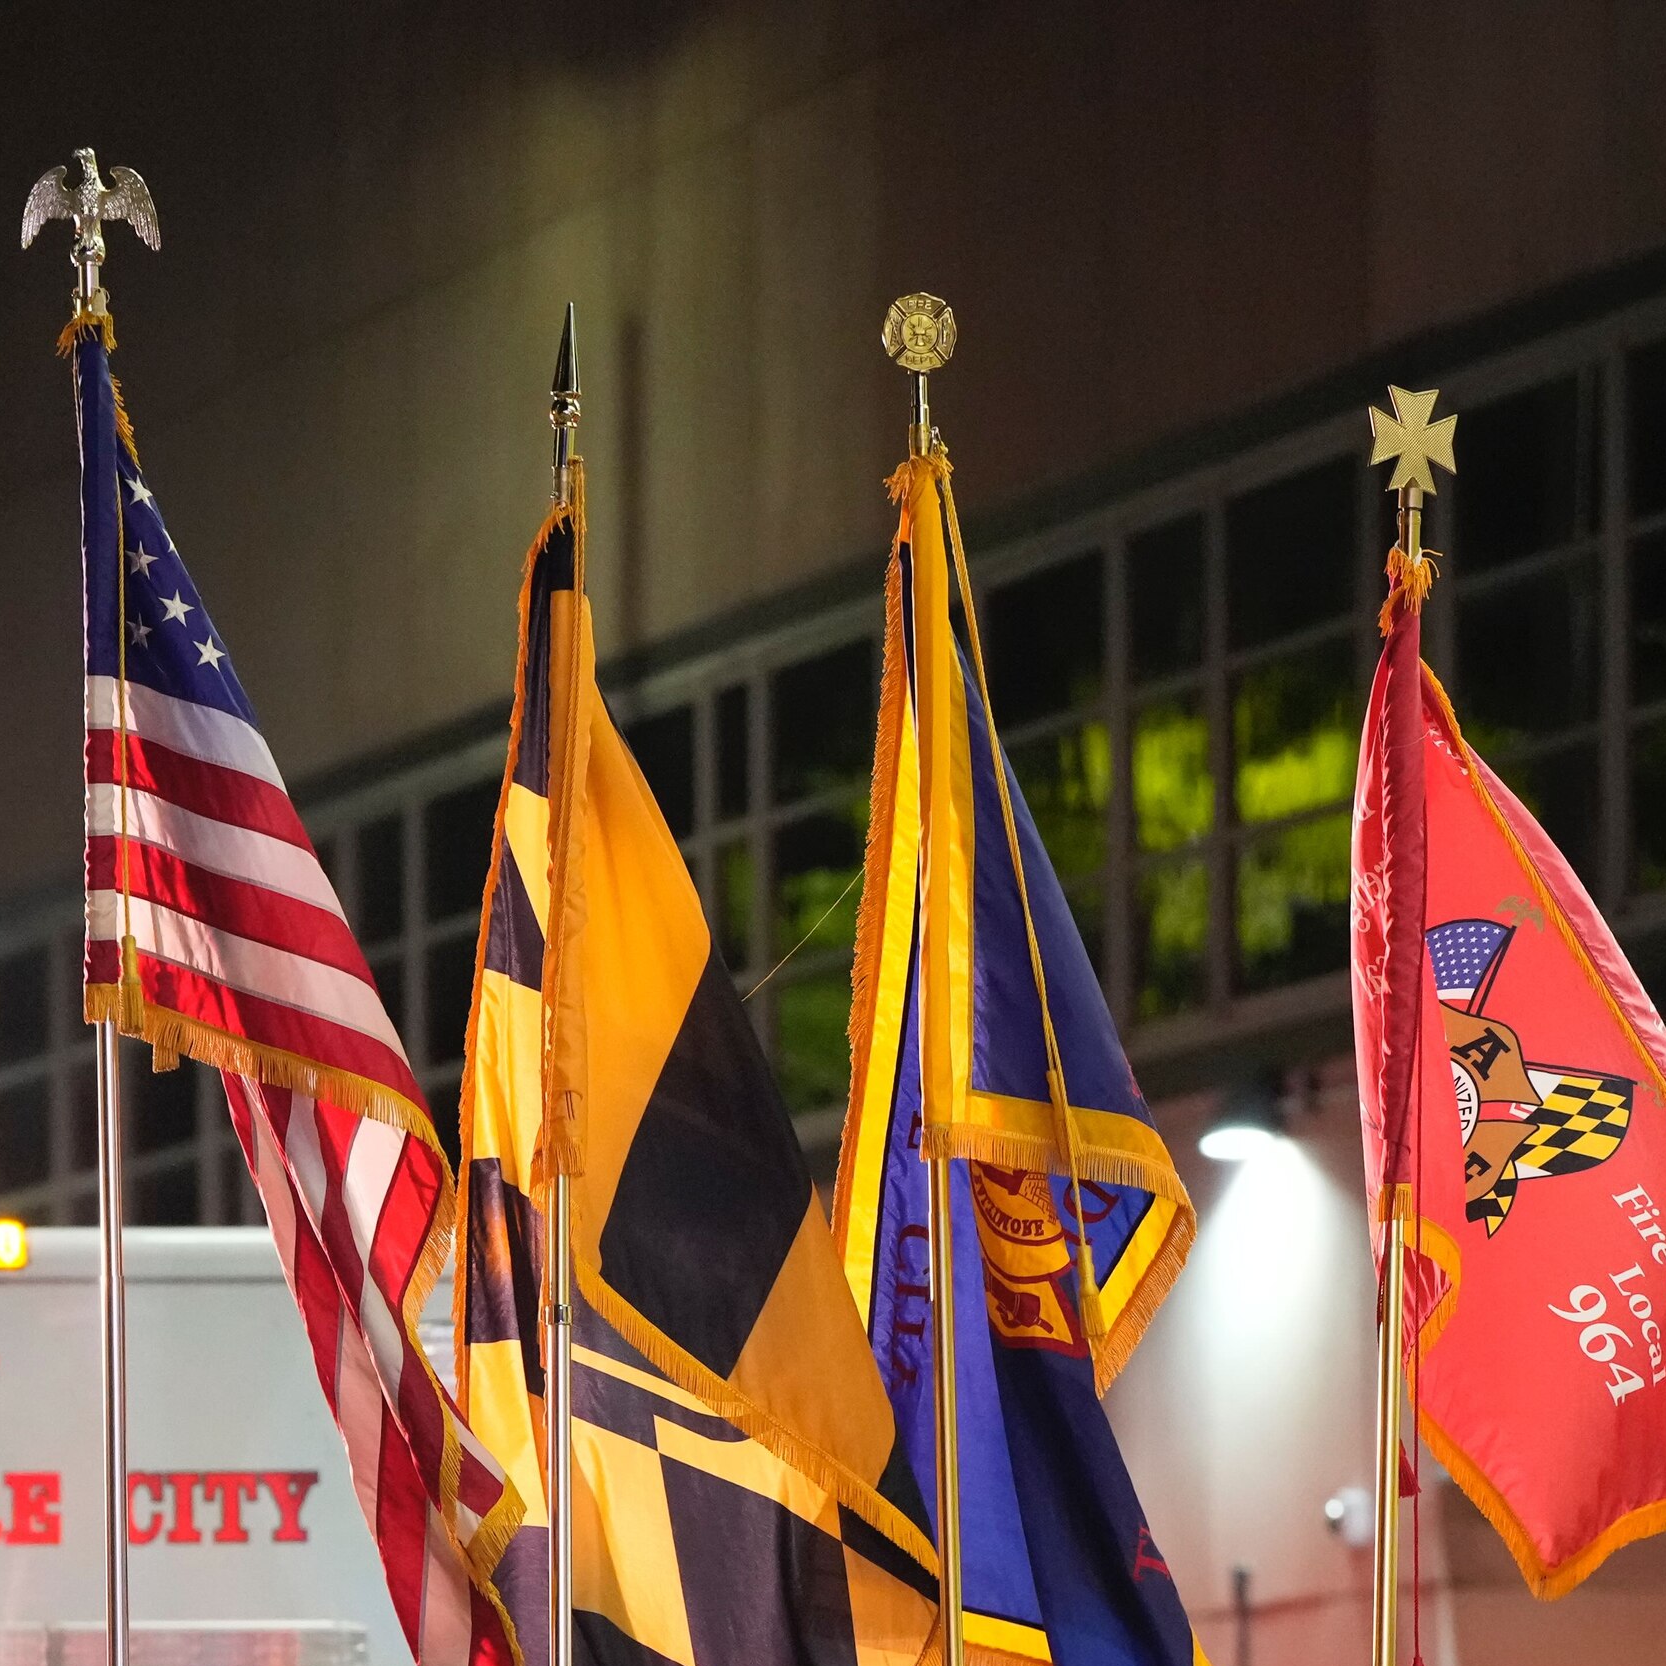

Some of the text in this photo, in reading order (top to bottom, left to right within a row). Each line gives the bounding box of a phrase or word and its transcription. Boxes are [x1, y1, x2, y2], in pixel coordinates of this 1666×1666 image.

[907, 299, 932, 310] FIRE
[1450, 1027, 1511, 1081] A
[1548, 1284, 1646, 1405] 964
[1609, 1265, 1666, 1386] Local
[127, 1470, 318, 1546] CITY
